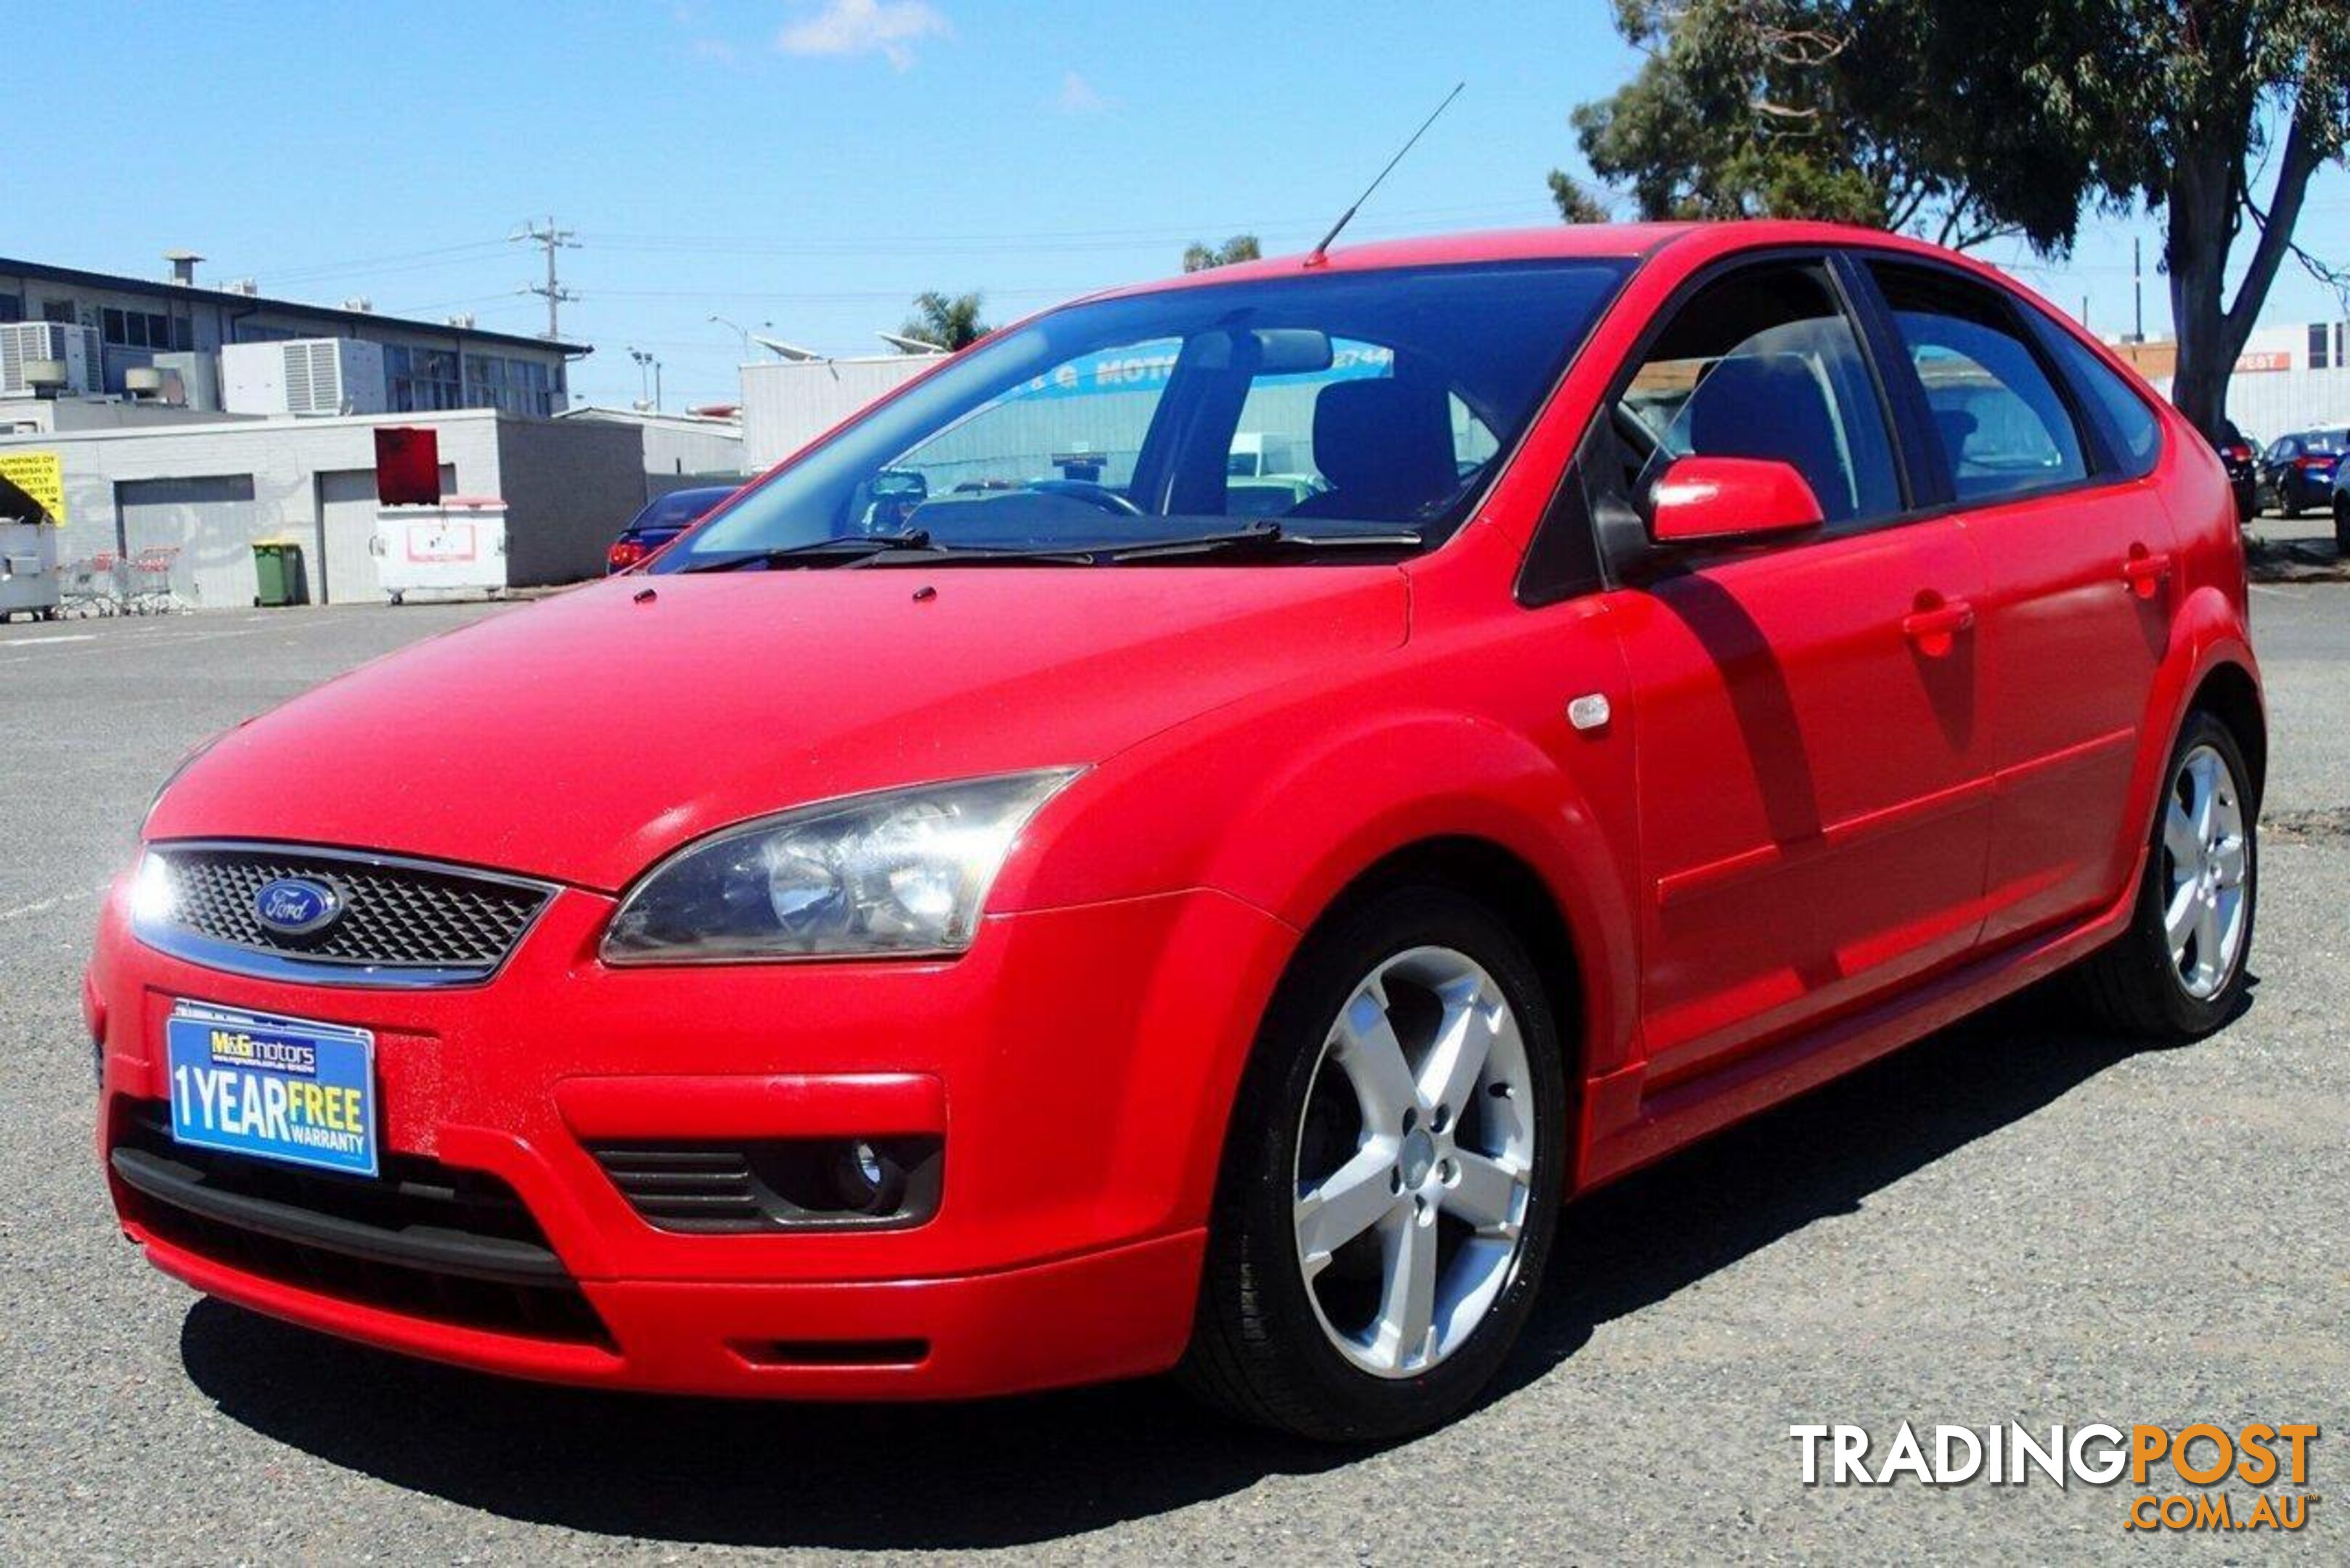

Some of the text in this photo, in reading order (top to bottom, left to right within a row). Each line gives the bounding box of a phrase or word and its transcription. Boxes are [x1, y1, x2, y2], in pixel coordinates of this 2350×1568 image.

[265, 888, 311, 921] Ford
[175, 1064, 363, 1143] 1 YEAR FREE
[291, 1124, 364, 1155] WARRANTY
